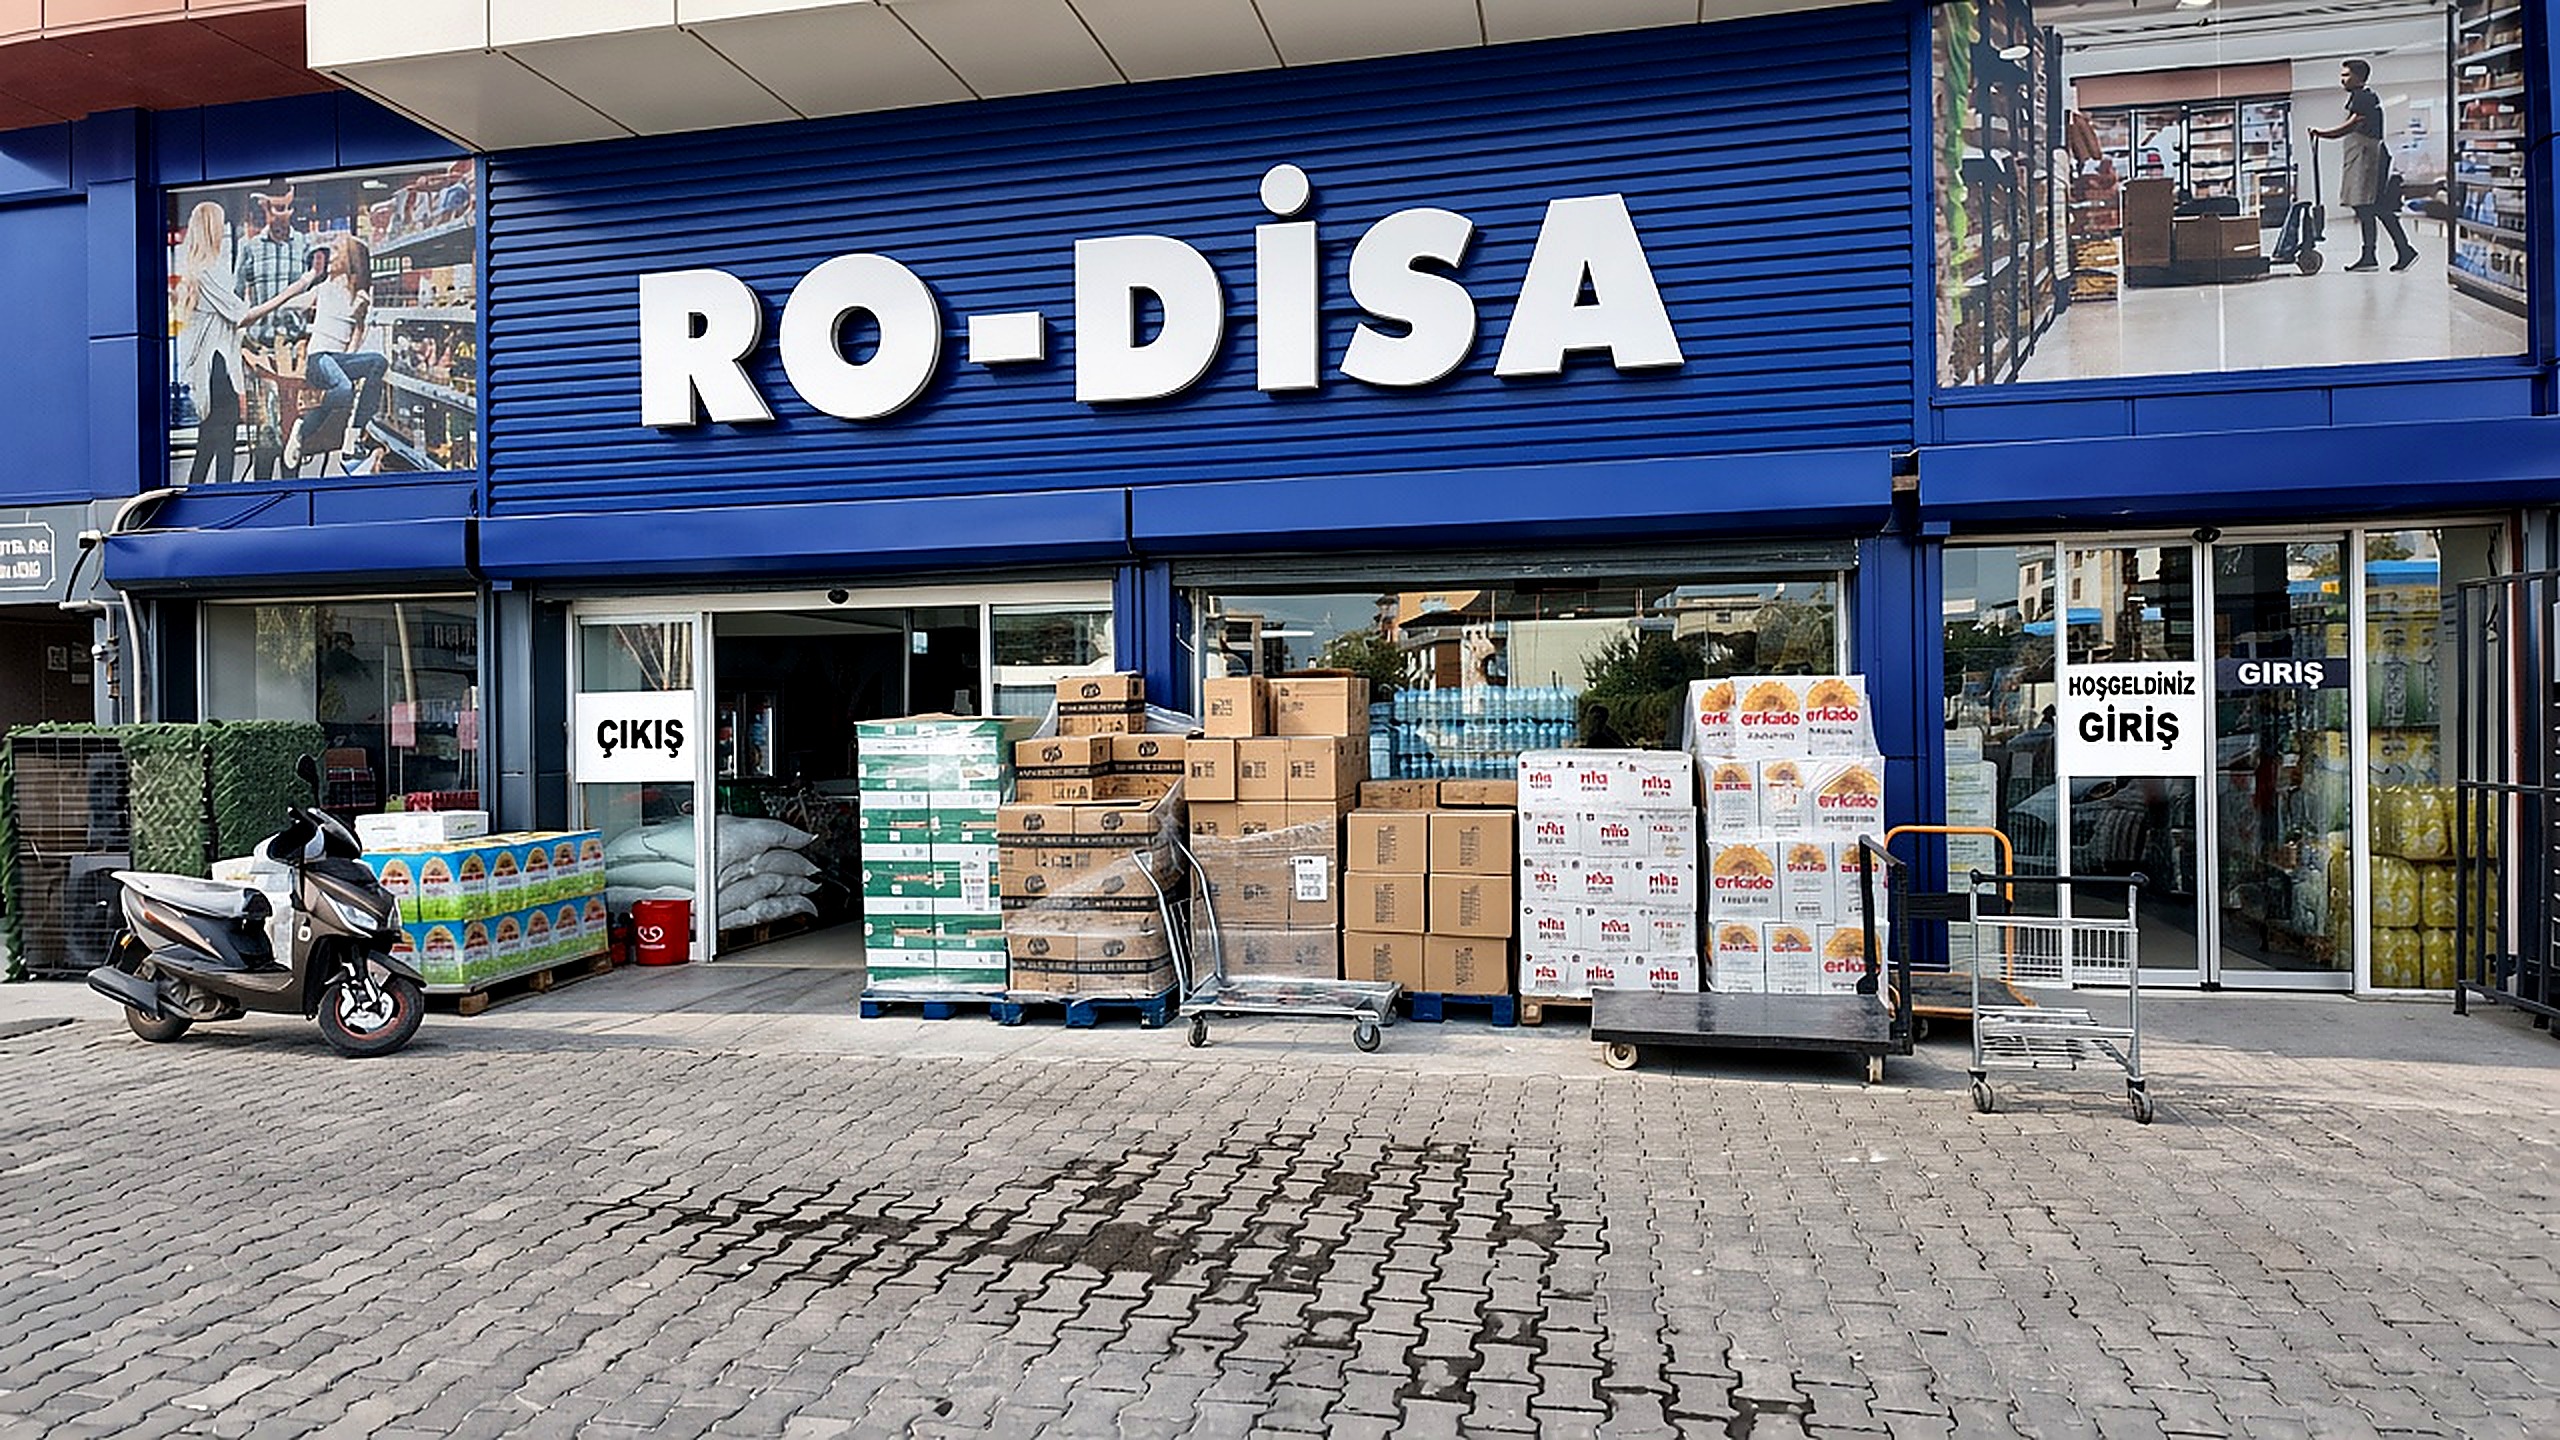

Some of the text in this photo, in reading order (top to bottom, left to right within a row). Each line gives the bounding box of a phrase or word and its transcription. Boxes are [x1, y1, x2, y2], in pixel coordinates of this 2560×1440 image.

[639, 163, 1685, 429] RO-DİSA
[2068, 670, 2196, 702] HOŞGELDİNİZ
[597, 719, 685, 759] ÇIKIŞ
[2078, 703, 2180, 751] GİRİŞ
